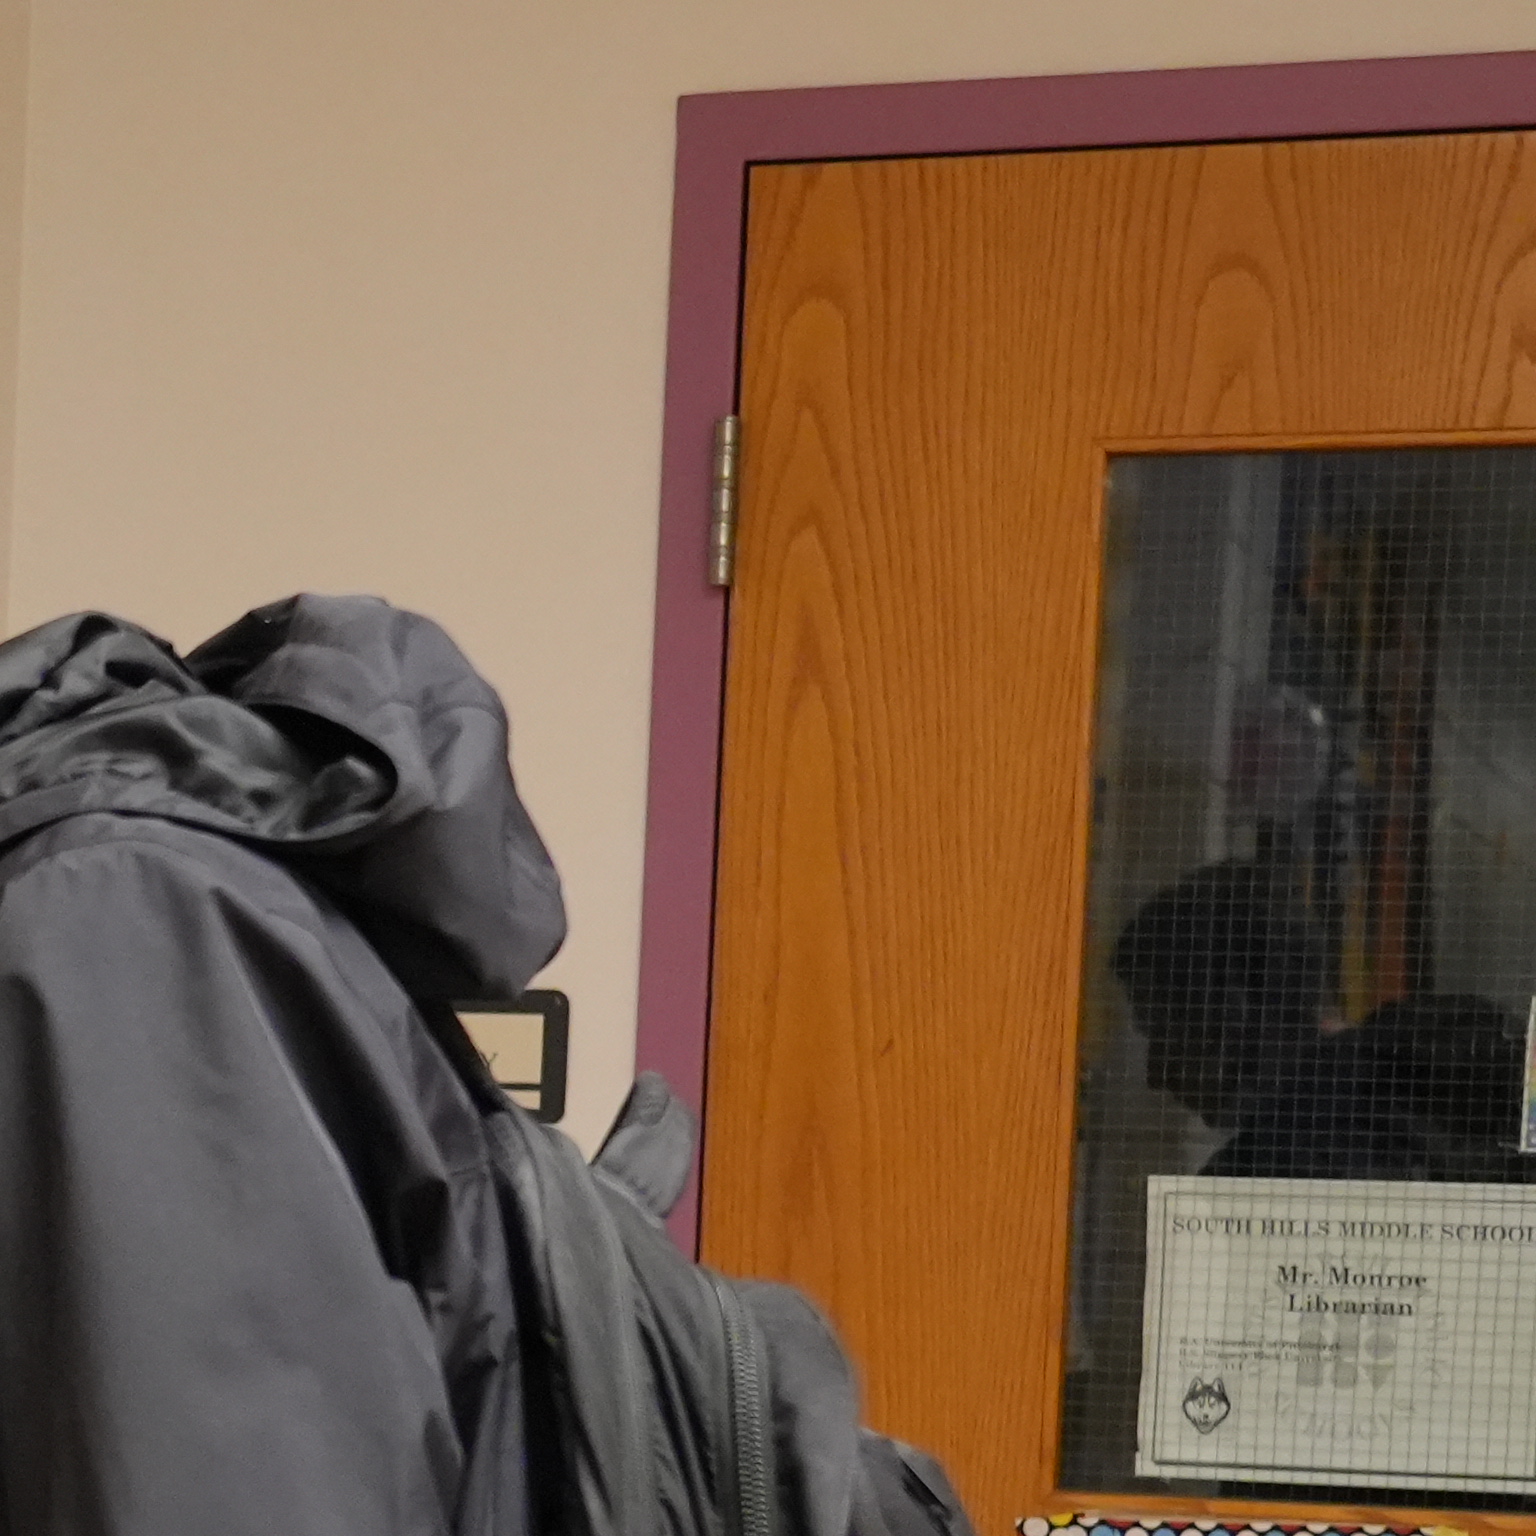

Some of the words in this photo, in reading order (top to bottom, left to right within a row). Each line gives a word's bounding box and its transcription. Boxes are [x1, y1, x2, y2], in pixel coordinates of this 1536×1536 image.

[1172, 1216, 1251, 1236] SOUTH
[1261, 1218, 1330, 1238] HILLS
[1339, 1220, 1432, 1242] MIDDLE
[1278, 1265, 1319, 1285] Mr.
[1329, 1267, 1427, 1288] Monroe
[1288, 1293, 1413, 1316] Librarian
